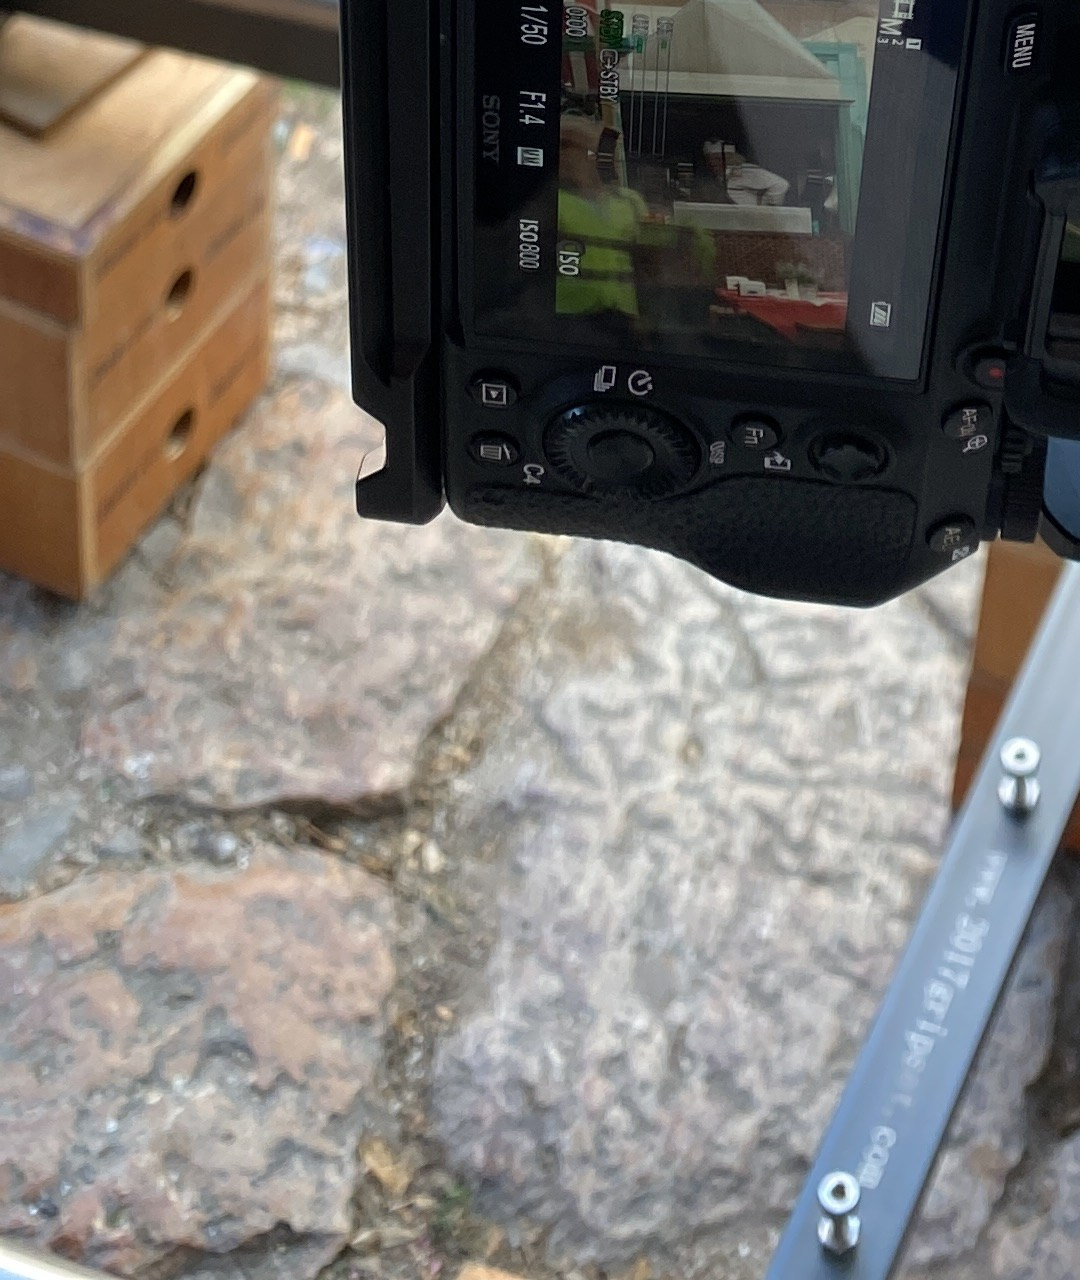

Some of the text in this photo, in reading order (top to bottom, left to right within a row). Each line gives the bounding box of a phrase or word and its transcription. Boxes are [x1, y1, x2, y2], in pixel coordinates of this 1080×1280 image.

[519, 4, 549, 46] 1/50
[1011, 23, 1036, 69] MENU
[600, 71, 619, 103] STBY
[518, 89, 547, 126] F1.4
[482, 94, 501, 163] SONY
[559, 250, 580, 276] ISO
[744, 426, 764, 446] Fn
[523, 463, 545, 485] C4
